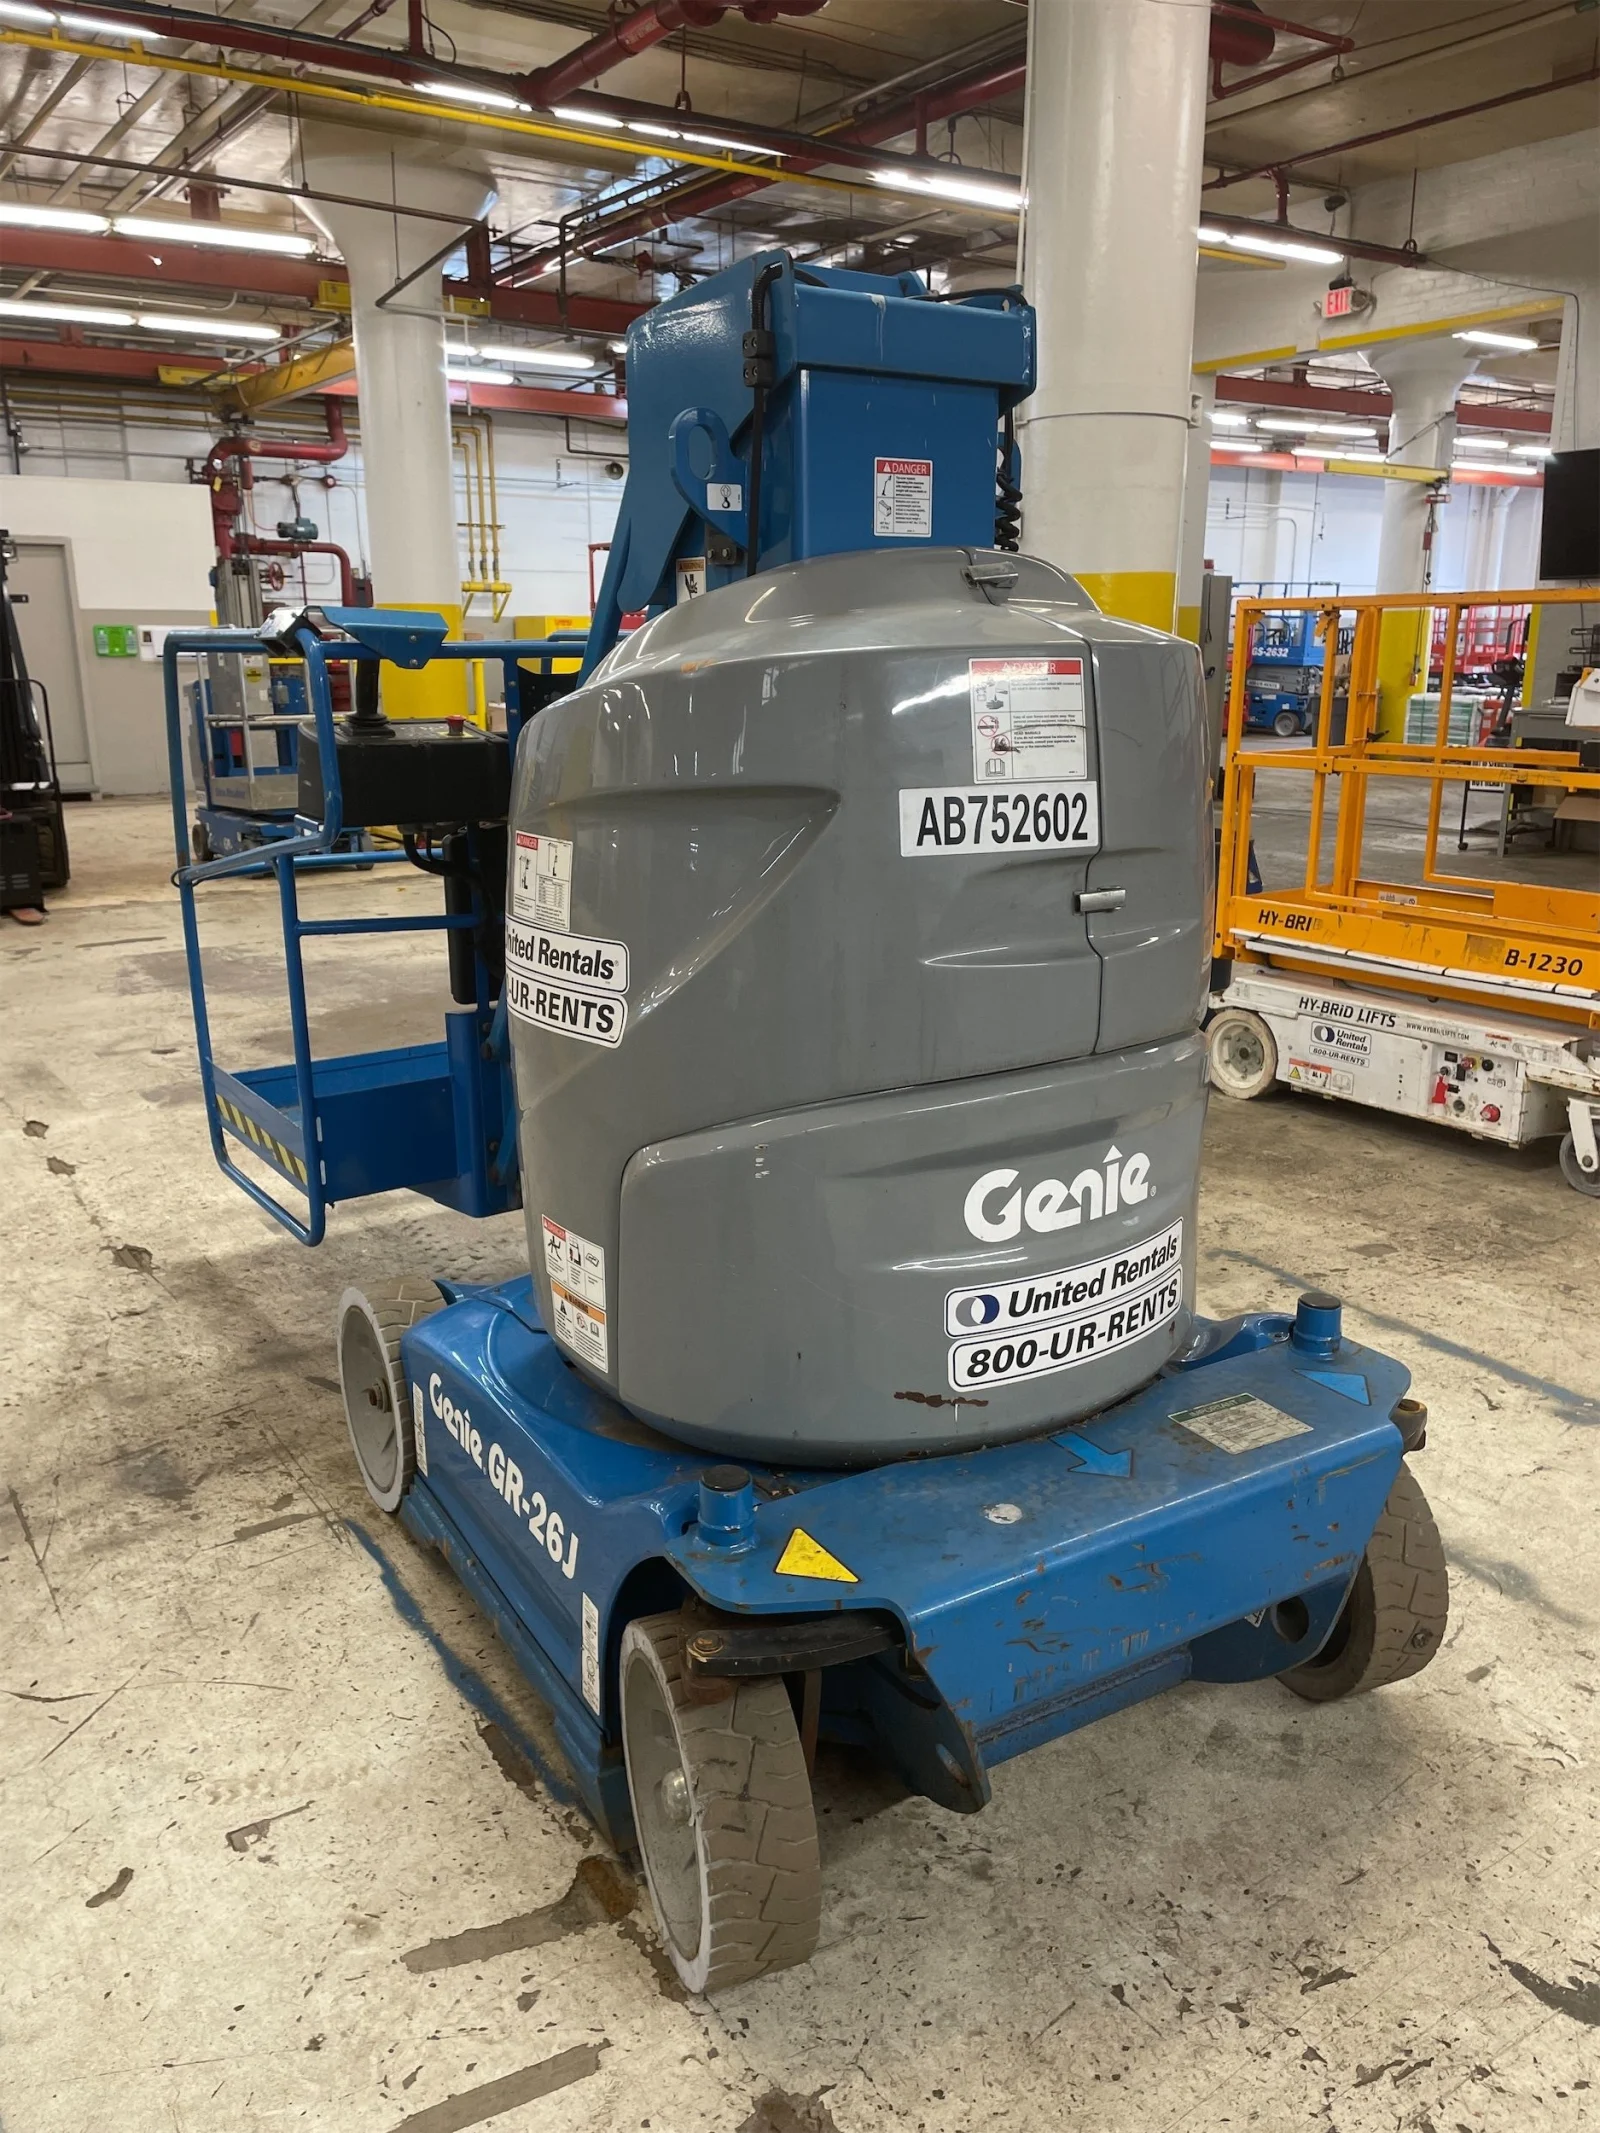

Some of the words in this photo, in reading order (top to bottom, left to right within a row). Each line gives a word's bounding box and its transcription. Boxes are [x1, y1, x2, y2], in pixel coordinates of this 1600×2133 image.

[1327, 290, 1350, 315] EXIT
[892, 463, 927, 474] DANGER
[1251, 646, 1289, 658] GS-2632
[1014, 661, 1056, 674] DANGR
[916, 792, 1088, 846] AB752602
[538, 937, 615, 980] Rentals
[1504, 948, 1583, 977] B-1230
[1357, 1008, 1396, 1028] LIFTS
[1335, 1038, 1368, 1052] Rentals
[1336, 1029, 1367, 1043] United
[964, 1145, 1151, 1243] Genie
[1008, 1268, 1107, 1318] United
[1110, 1235, 1178, 1290] Rentals
[966, 1278, 1179, 1378] 800-UR-RENTS
[429, 1372, 483, 1470] Genie
[488, 1443, 579, 1580] GR-26J
